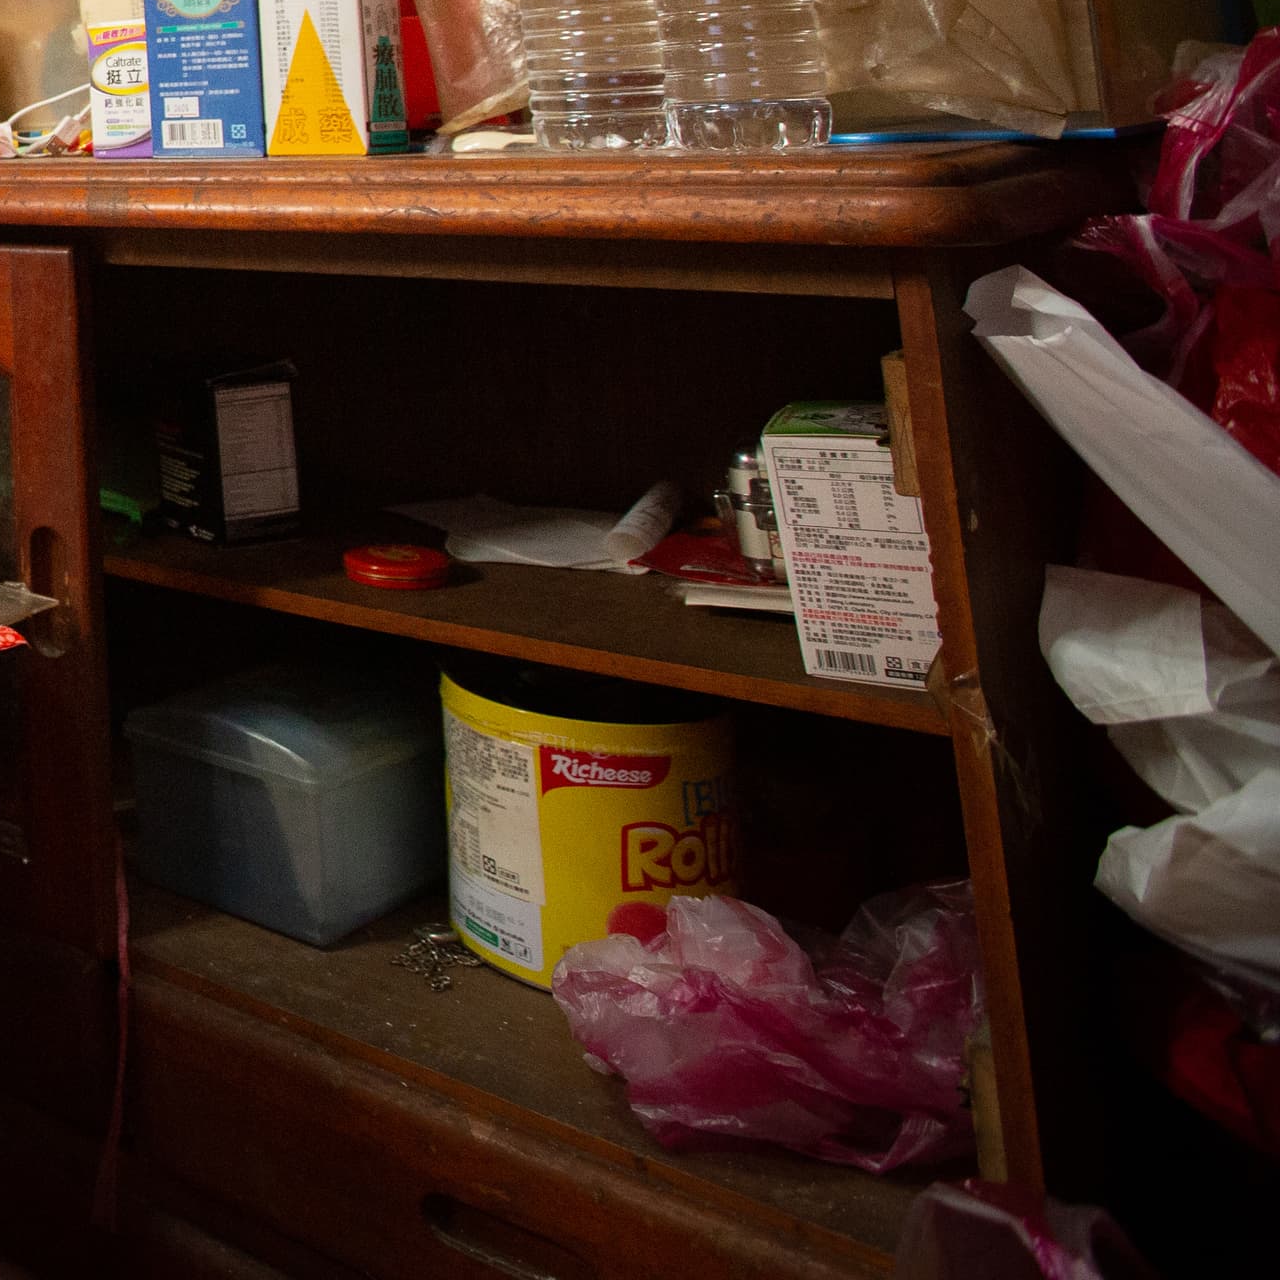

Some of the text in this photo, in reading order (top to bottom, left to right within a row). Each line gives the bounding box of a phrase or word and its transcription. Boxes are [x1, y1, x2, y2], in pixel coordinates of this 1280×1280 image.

[105, 56, 142, 69] Caltrate
[106, 68, 143, 86] 挺立
[277, 107, 354, 144] 成藥
[550, 753, 654, 786] Richeese
